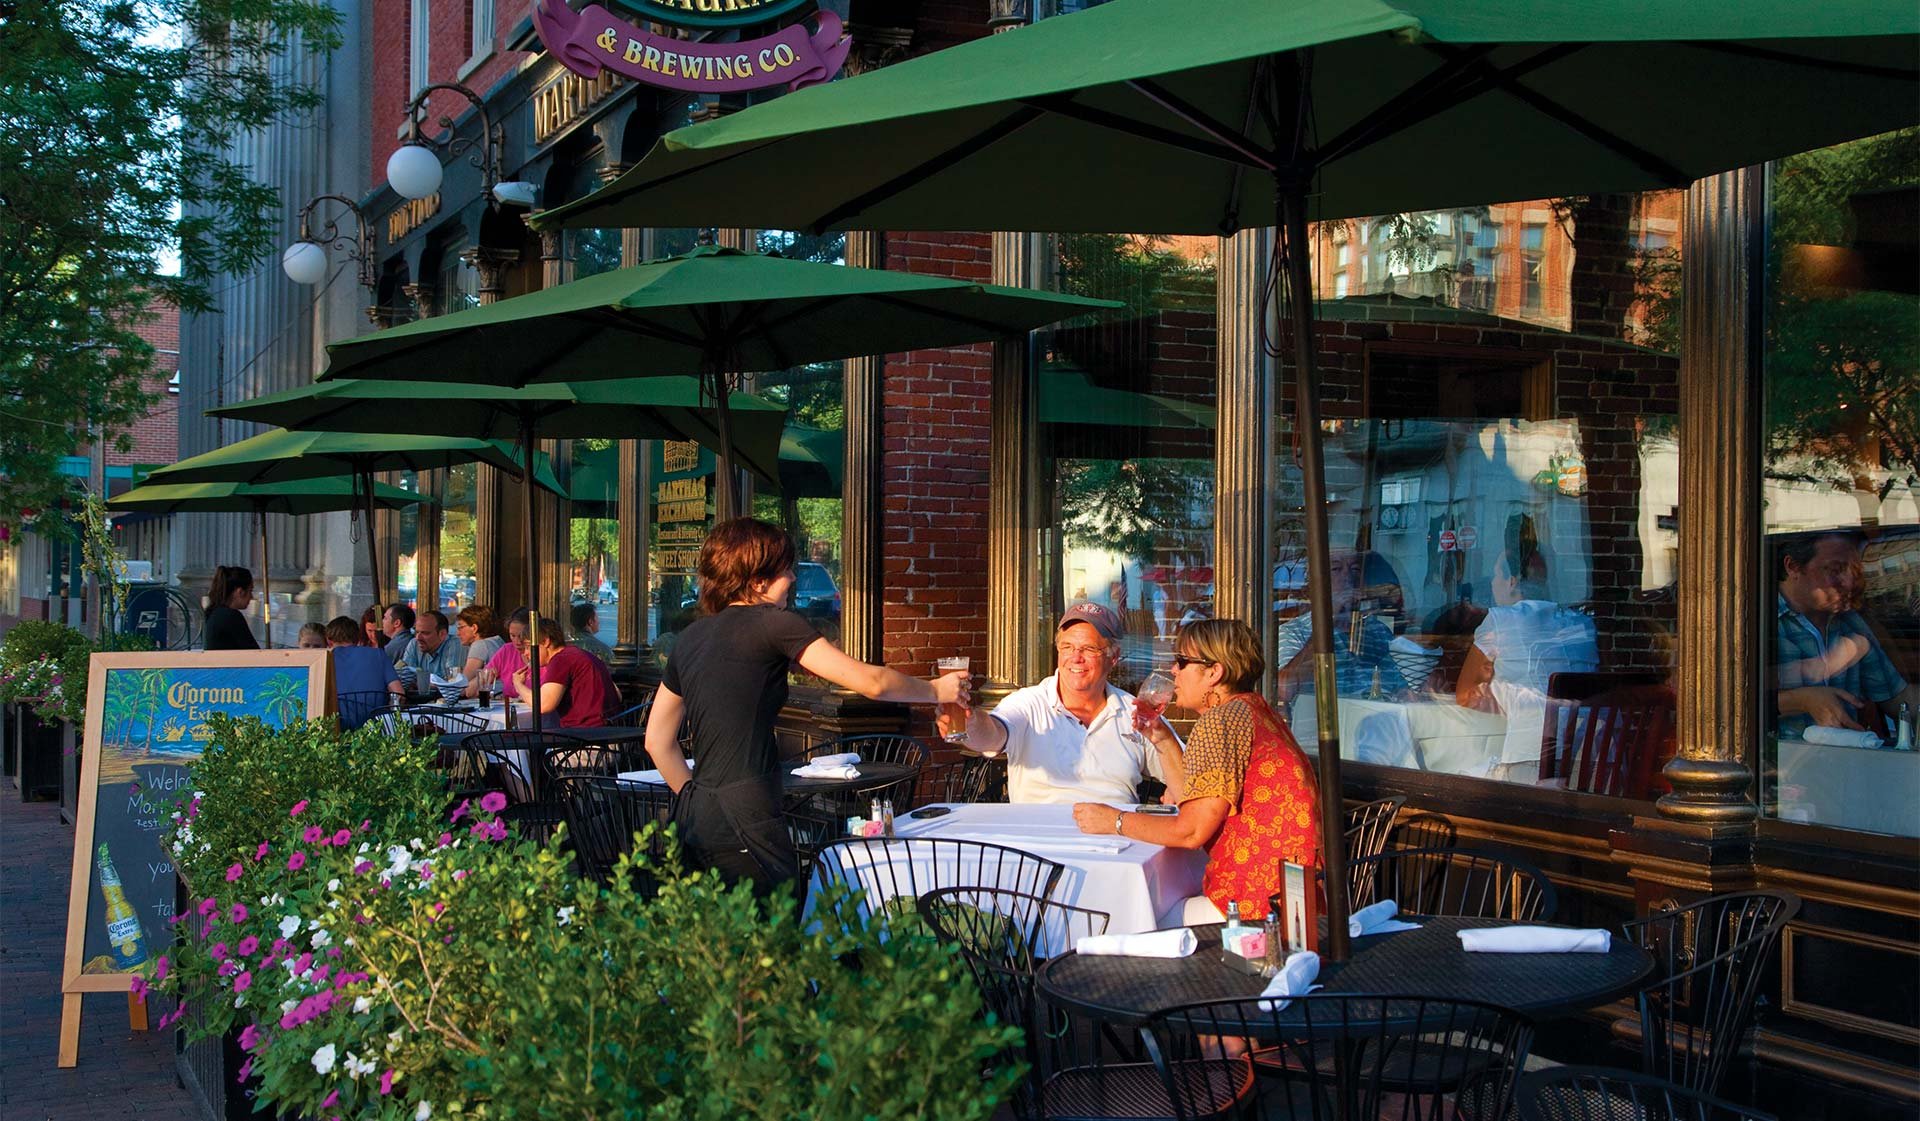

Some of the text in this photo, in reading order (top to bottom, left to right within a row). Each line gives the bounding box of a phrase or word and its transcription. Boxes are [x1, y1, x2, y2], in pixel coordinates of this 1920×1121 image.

[596, 27, 801, 81] & BREWING CO.
[656, 550, 678, 568] SWEET
[167, 681, 244, 711] Corona
[110, 918, 137, 934] Corona
